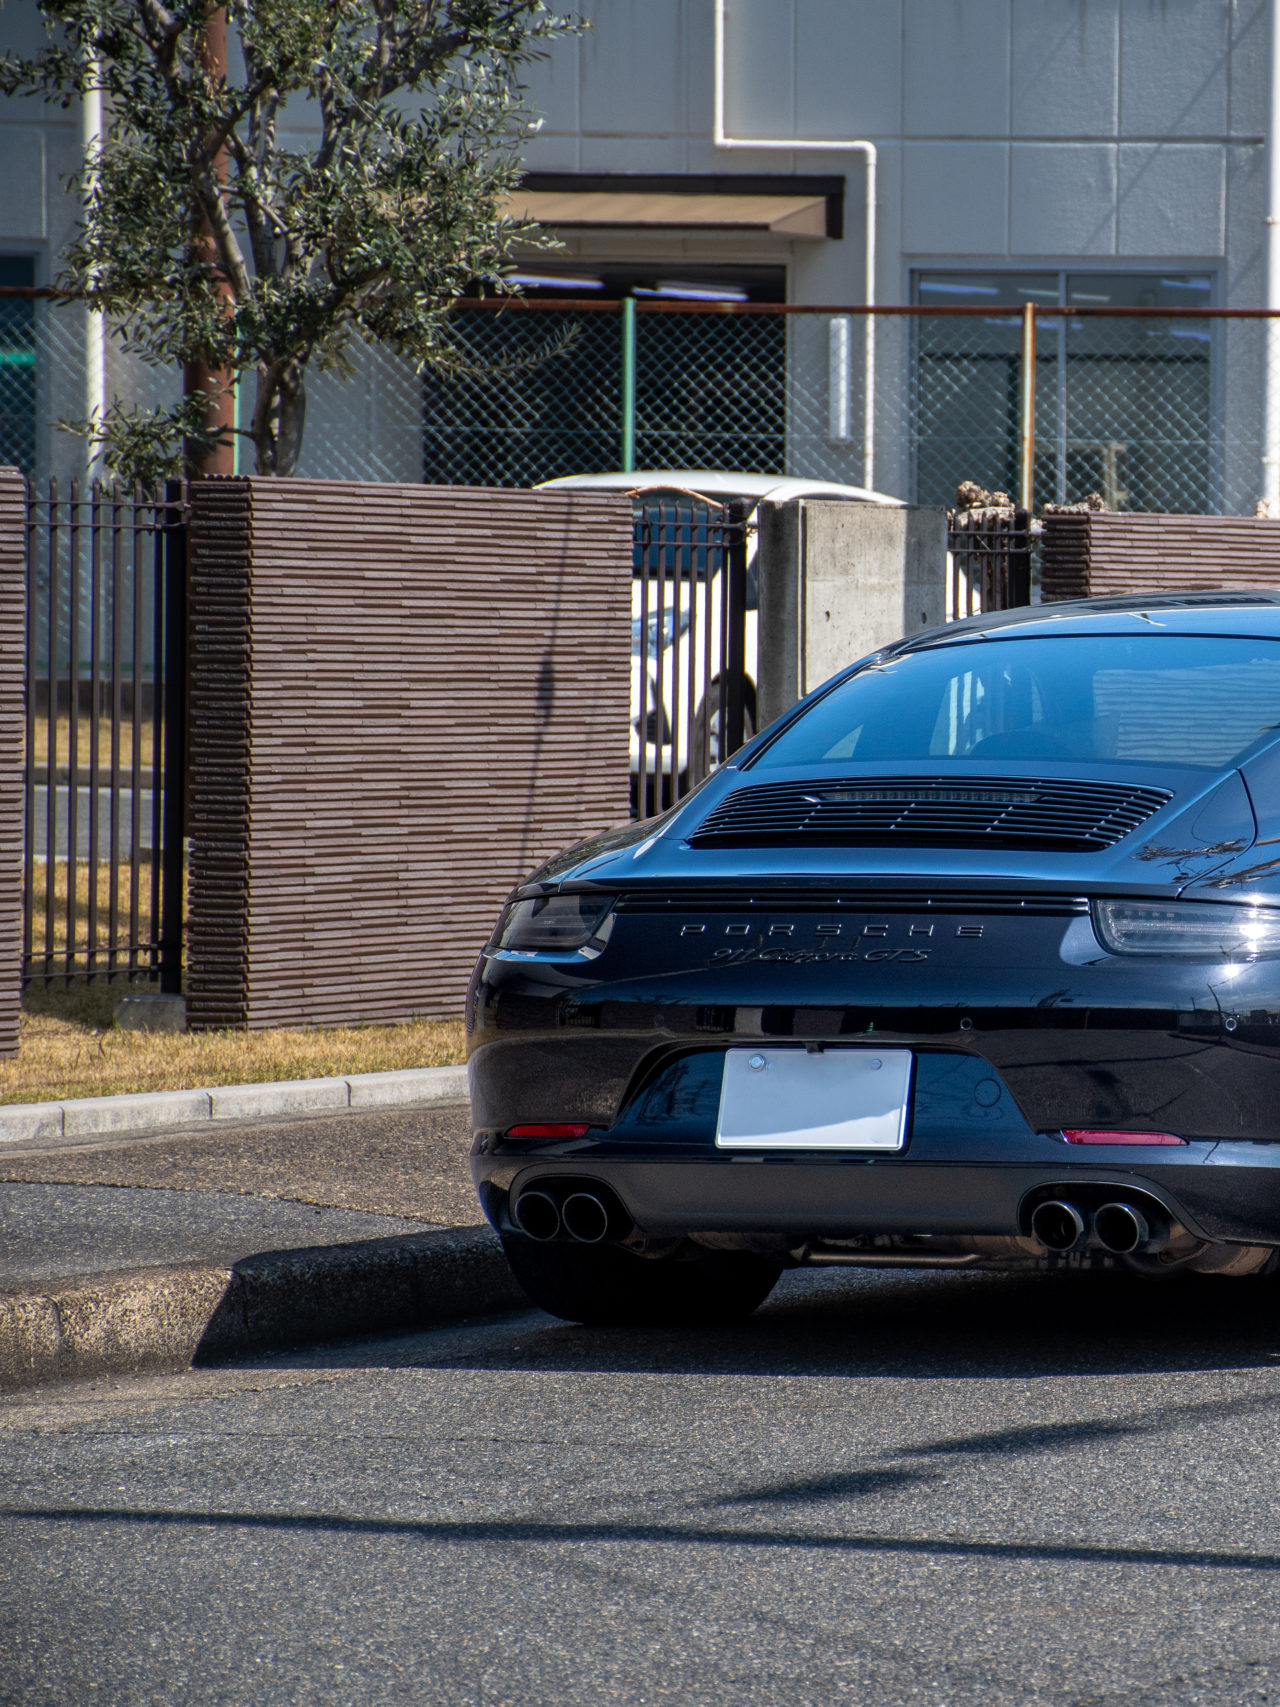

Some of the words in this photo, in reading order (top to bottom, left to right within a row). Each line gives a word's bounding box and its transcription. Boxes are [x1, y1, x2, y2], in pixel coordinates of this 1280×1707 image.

[680, 923, 985, 938] PORSCHE
[712, 948, 756, 962] 911
[757, 947, 859, 964] Carrera
[863, 948, 934, 963] GTS
